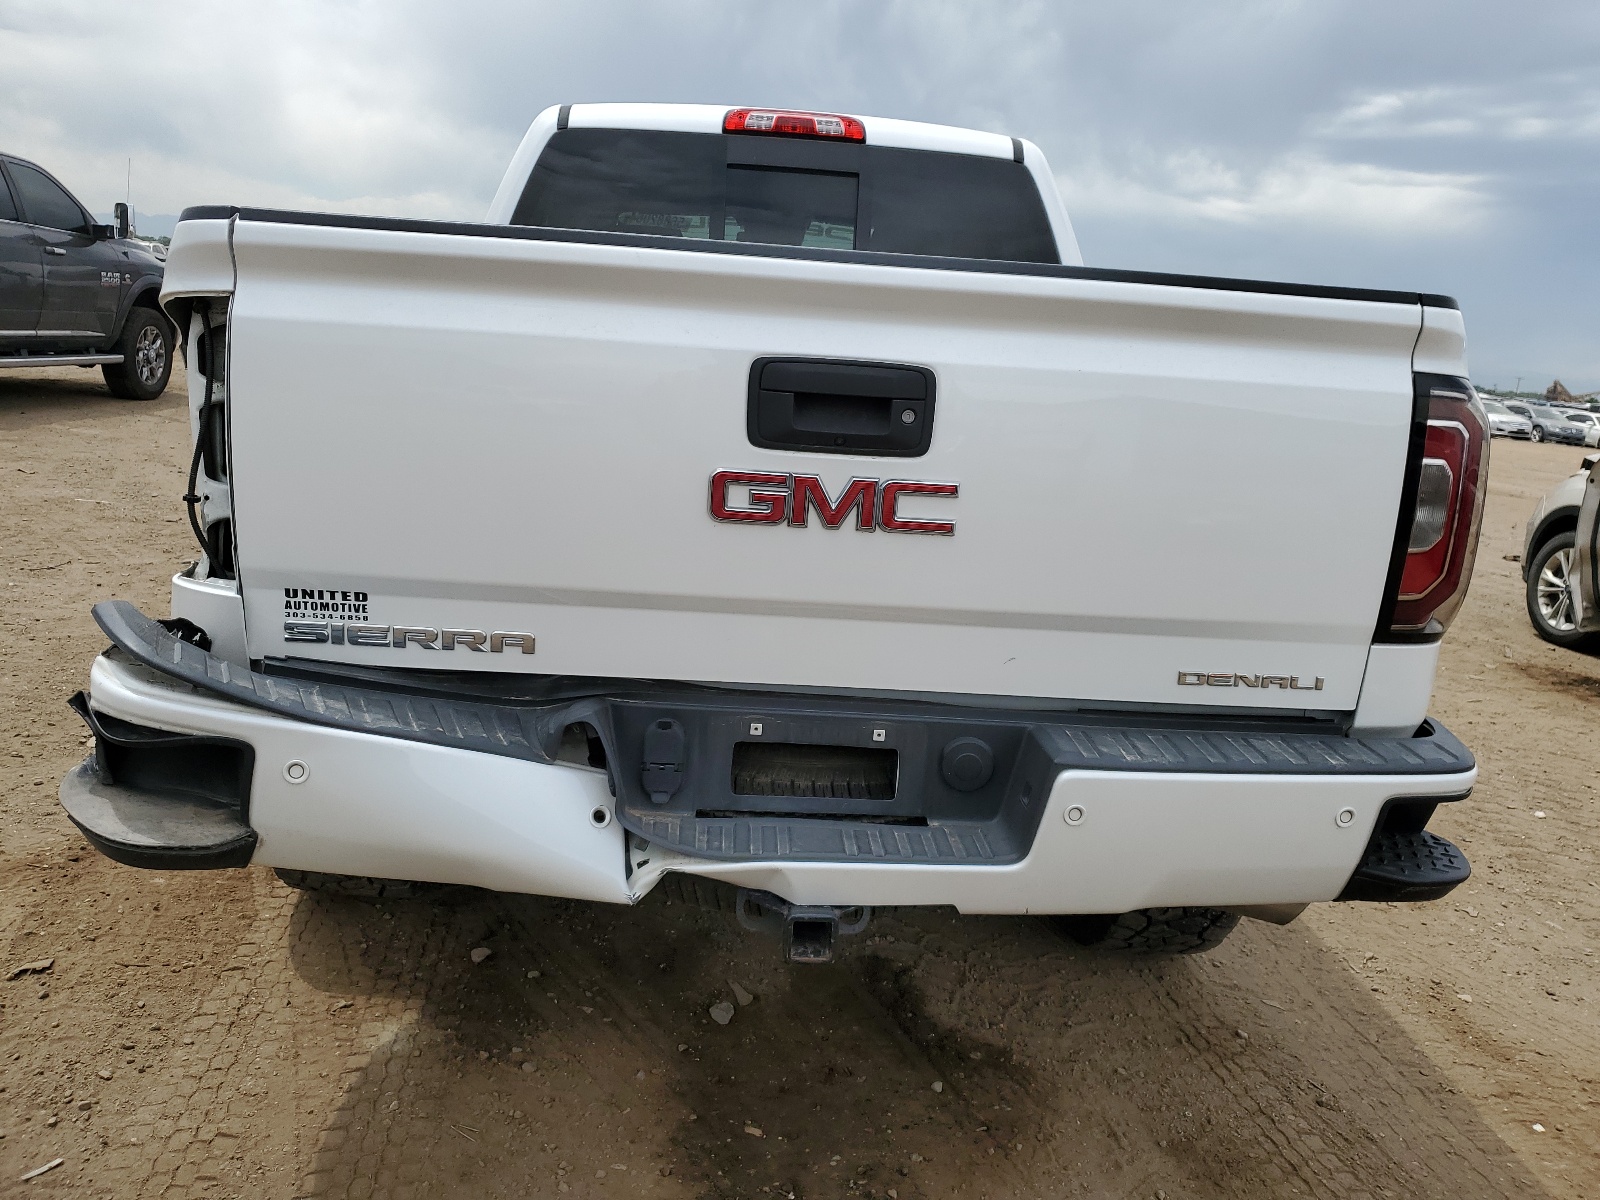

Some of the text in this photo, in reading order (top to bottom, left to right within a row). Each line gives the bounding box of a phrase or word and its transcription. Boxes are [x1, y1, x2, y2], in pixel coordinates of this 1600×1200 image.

[708, 467, 960, 537] GMC
[284, 588, 368, 602] UNITED
[284, 601, 368, 613] AUTOMOTIVE
[284, 621, 535, 654] SIERRA
[1177, 670, 1325, 690] DENALI
